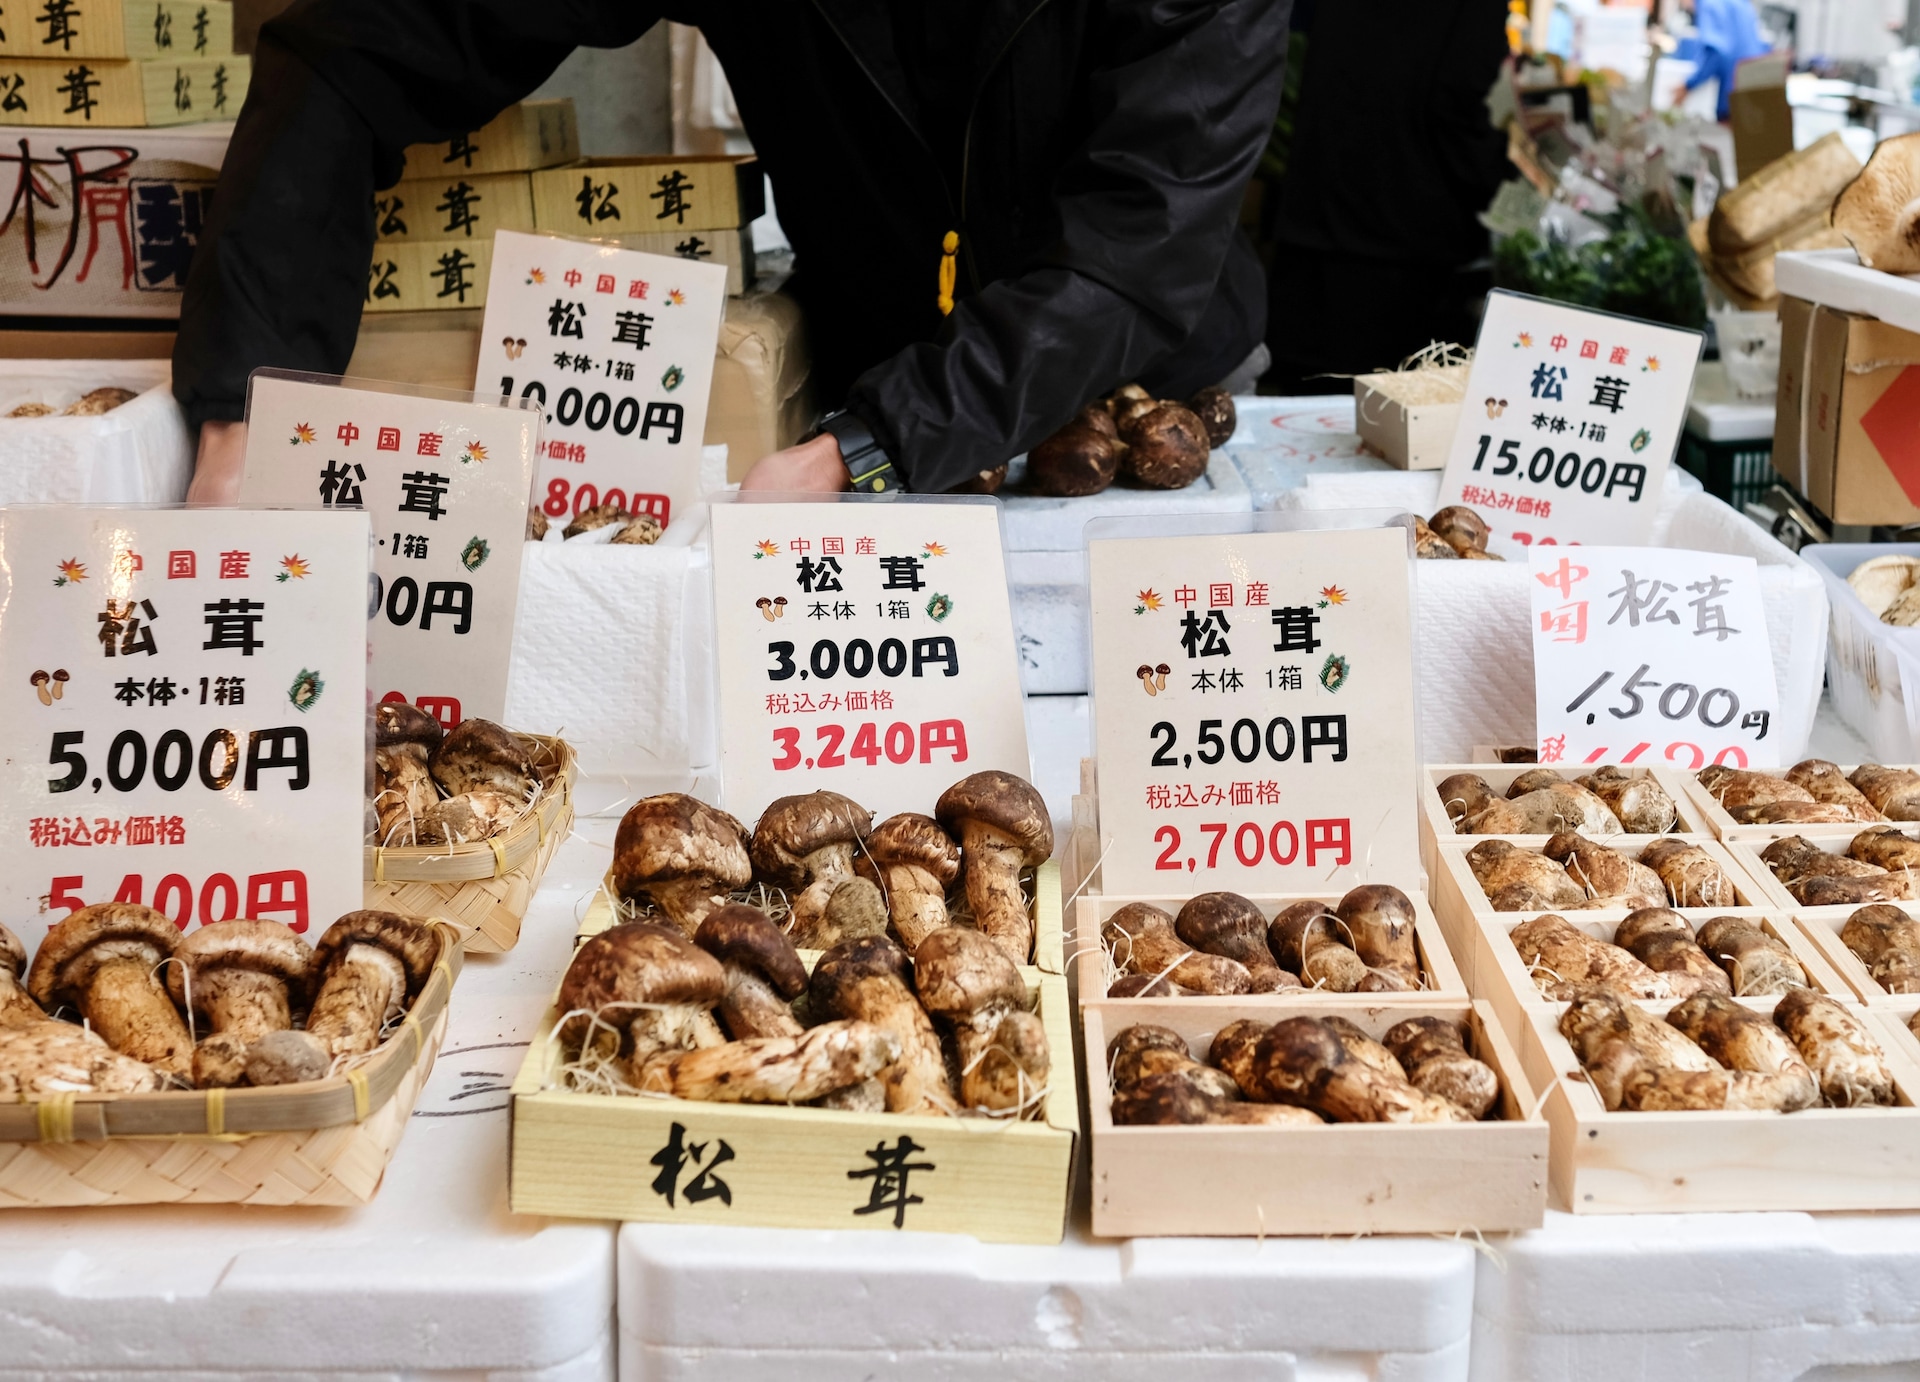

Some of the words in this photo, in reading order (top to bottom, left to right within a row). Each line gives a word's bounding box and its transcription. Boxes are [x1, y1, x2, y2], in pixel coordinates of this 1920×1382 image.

[576, 170, 694, 224] 松茸
[564, 269, 649, 300] 中国産
[548, 299, 654, 350] 松茸
[1550, 334, 1629, 366] 中国産
[1530, 362, 1630, 414] 松茸
[336, 422, 443, 457] 中国産
[319, 460, 450, 521] 松茸
[1472, 435, 1647, 502] 15,000円
[1461, 485, 1552, 519] 税込み価格
[114, 549, 252, 580] 中国産
[789, 536, 878, 556] 中国産
[795, 555, 926, 593] 松茸
[1173, 580, 1271, 609] 中国産
[1535, 557, 1590, 644] 中国
[1607, 569, 1741, 642] 松茸
[98, 598, 265, 658] 松茸
[1180, 606, 1321, 659] 松茸
[767, 636, 959, 681] 3,000円
[765, 690, 895, 715] 税込み価格
[48, 726, 310, 794] 5,000円
[771, 719, 969, 771] 3,240円
[1150, 714, 1348, 769] 2,500円
[1146, 779, 1281, 810] 税込み価格
[29, 815, 187, 848] 税込み価格
[1153, 818, 1352, 873] 2,700円
[47, 870, 310, 935] 500円
[650, 1122, 935, 1229] 松茸
